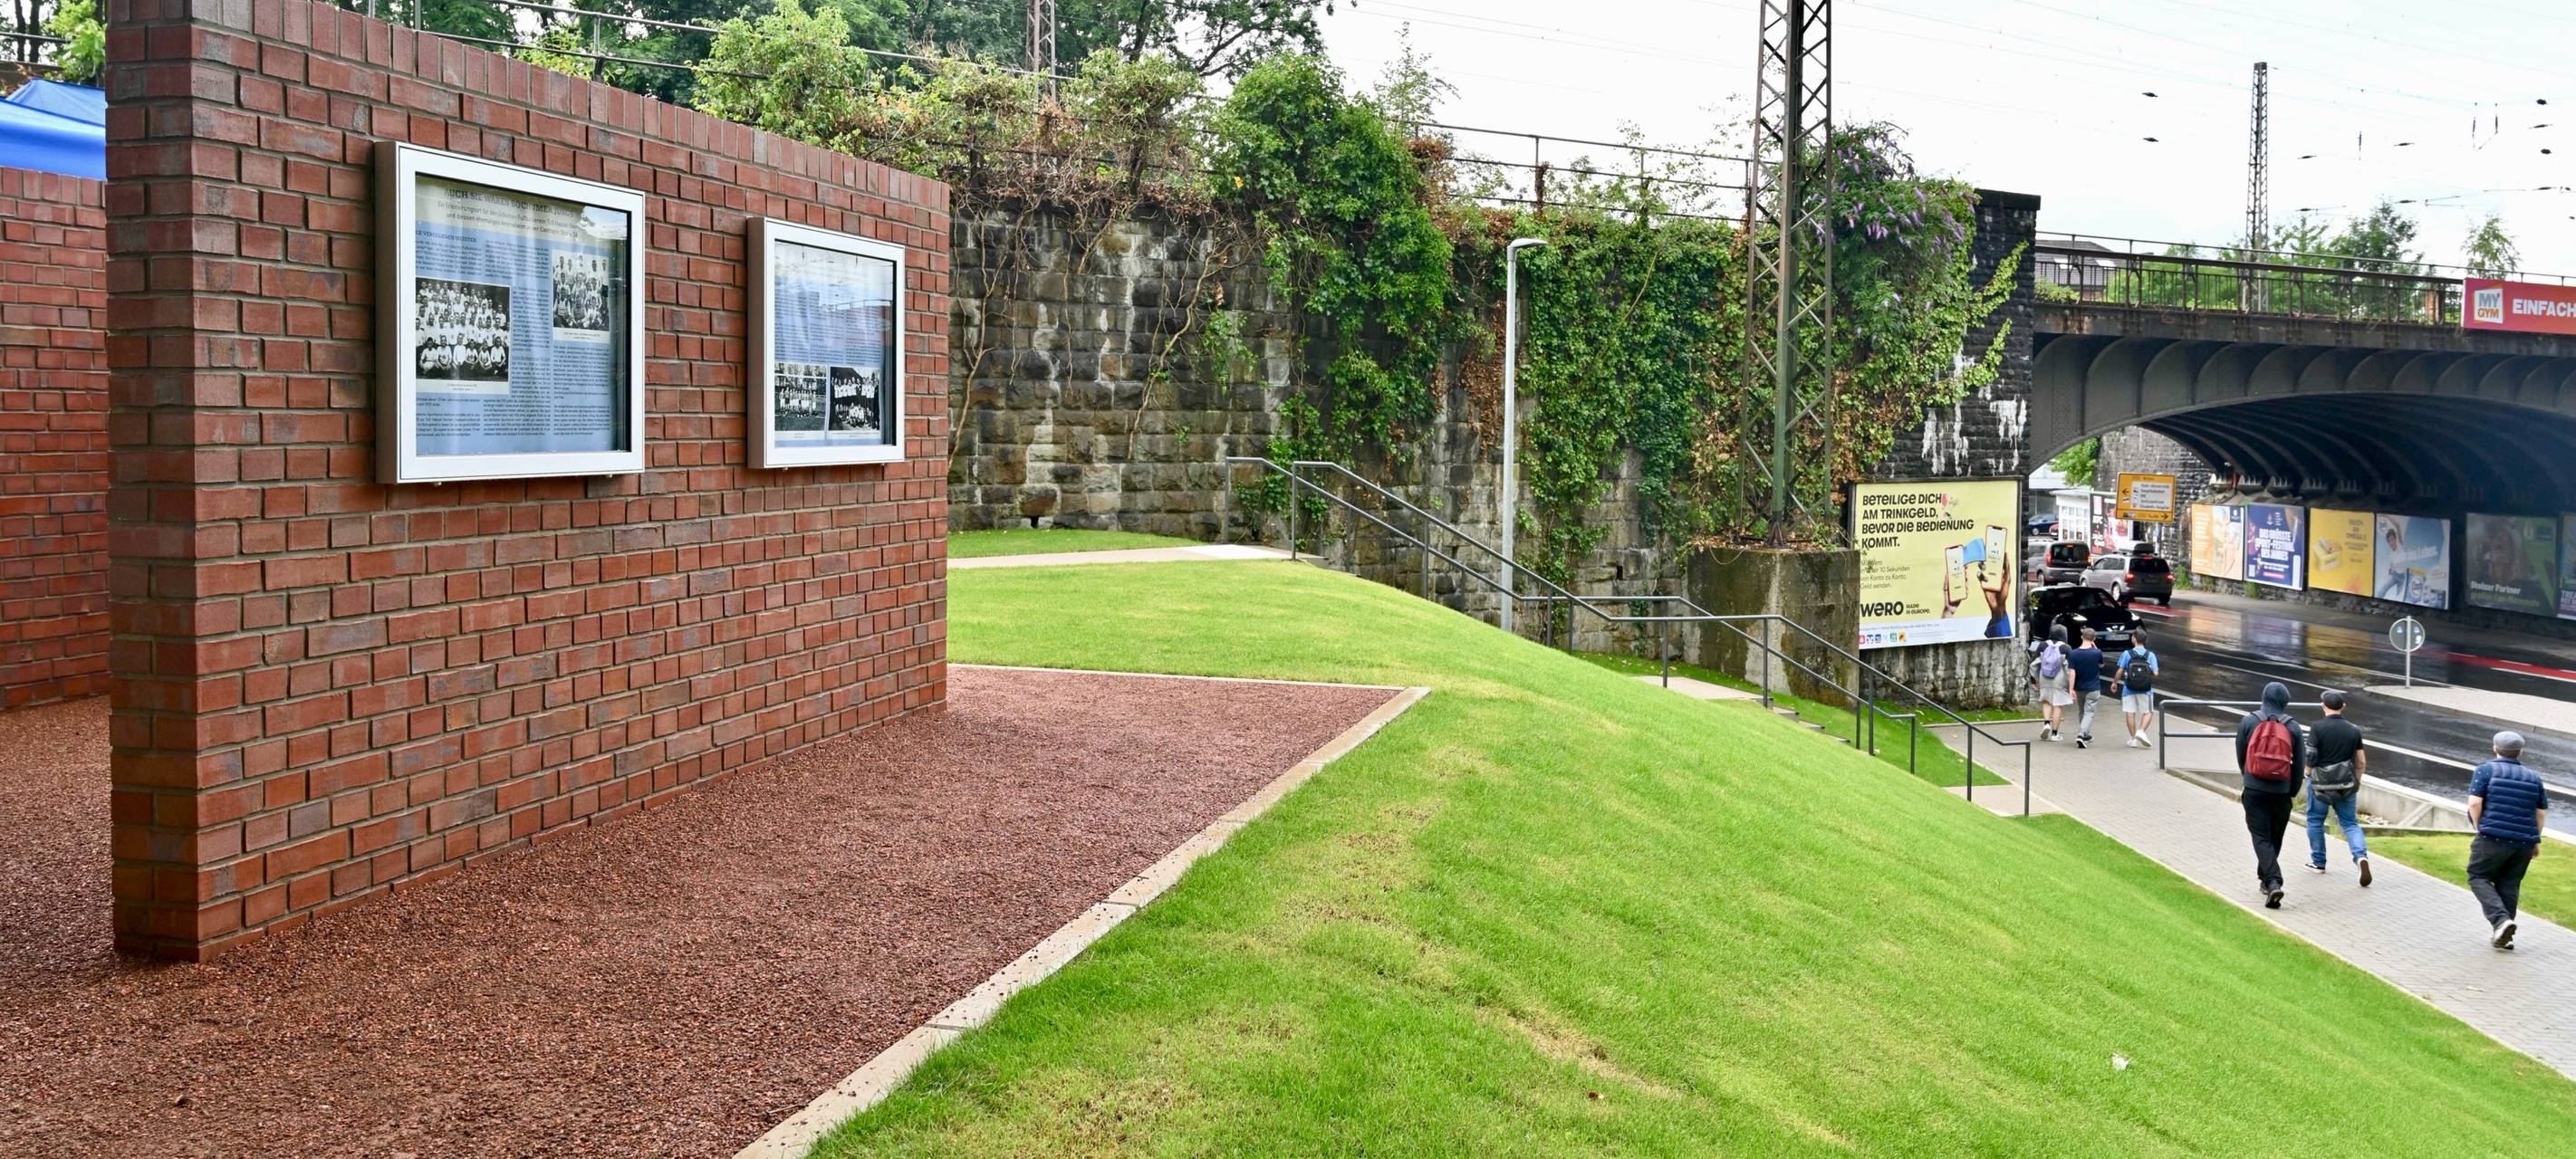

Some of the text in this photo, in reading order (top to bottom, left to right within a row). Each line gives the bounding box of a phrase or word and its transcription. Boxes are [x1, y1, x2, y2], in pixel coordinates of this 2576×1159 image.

[445, 187, 468, 199] AUCH
[470, 191, 483, 201] SIE
[484, 193, 510, 206] WAREN
[2478, 292, 2501, 309] MY
[2477, 308, 2500, 320] GYM
[2512, 298, 2576, 318] EINFACH
[1918, 493, 1942, 504] DICH
[1862, 509, 1879, 520] AM
[1861, 536, 1900, 549] KOMMT.
